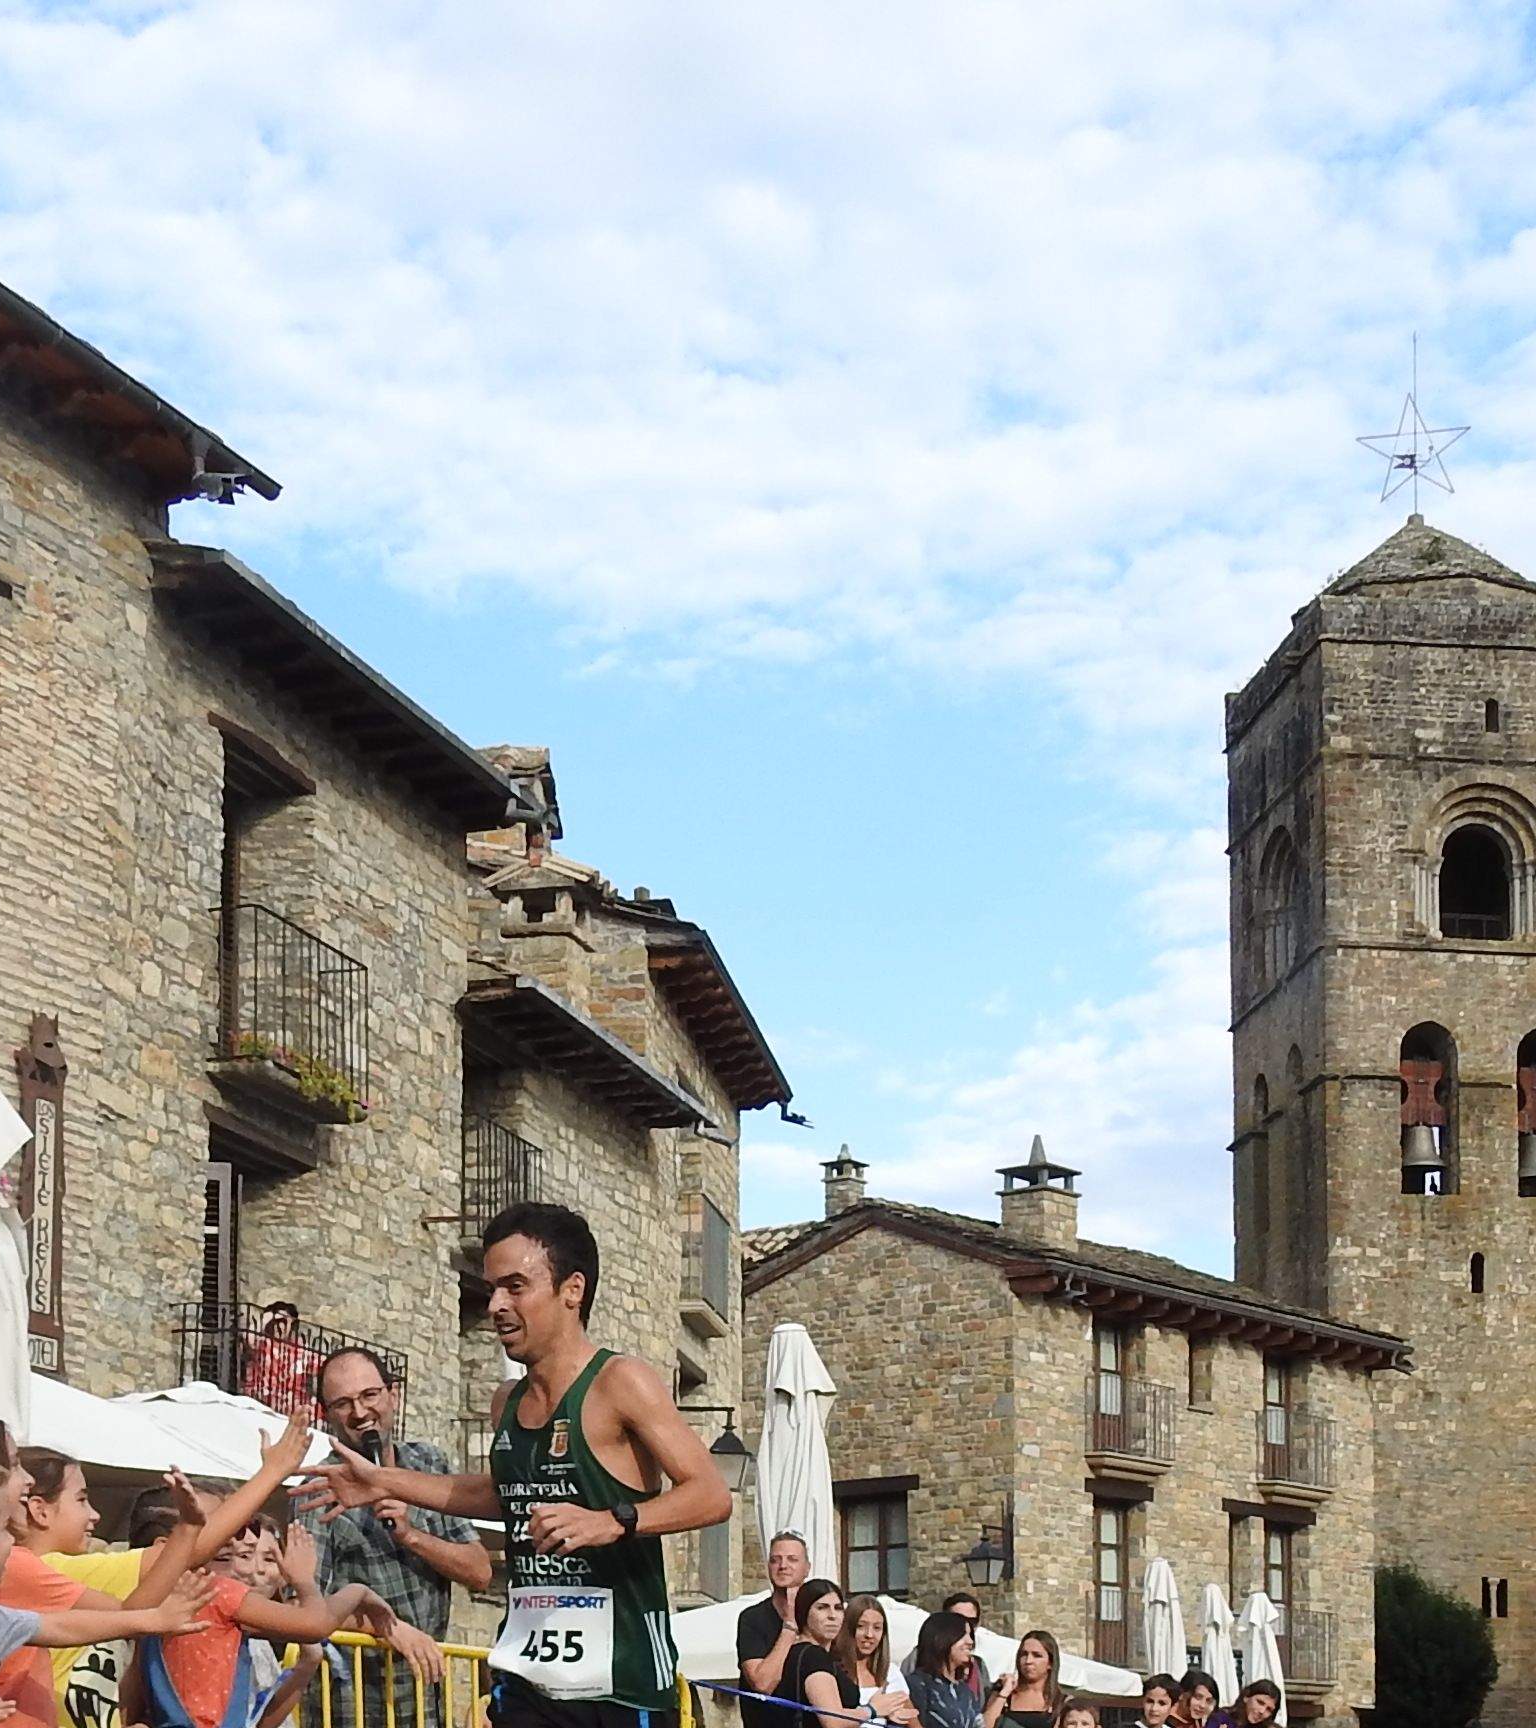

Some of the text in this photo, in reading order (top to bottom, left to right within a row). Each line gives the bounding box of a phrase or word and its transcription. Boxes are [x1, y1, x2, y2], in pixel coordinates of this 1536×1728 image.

[35, 1117, 52, 1313] SIETE REYES
[28, 1338, 54, 1368] OTEL
[521, 1595, 607, 1609] INTERSPORT
[520, 1629, 584, 1663] 455
